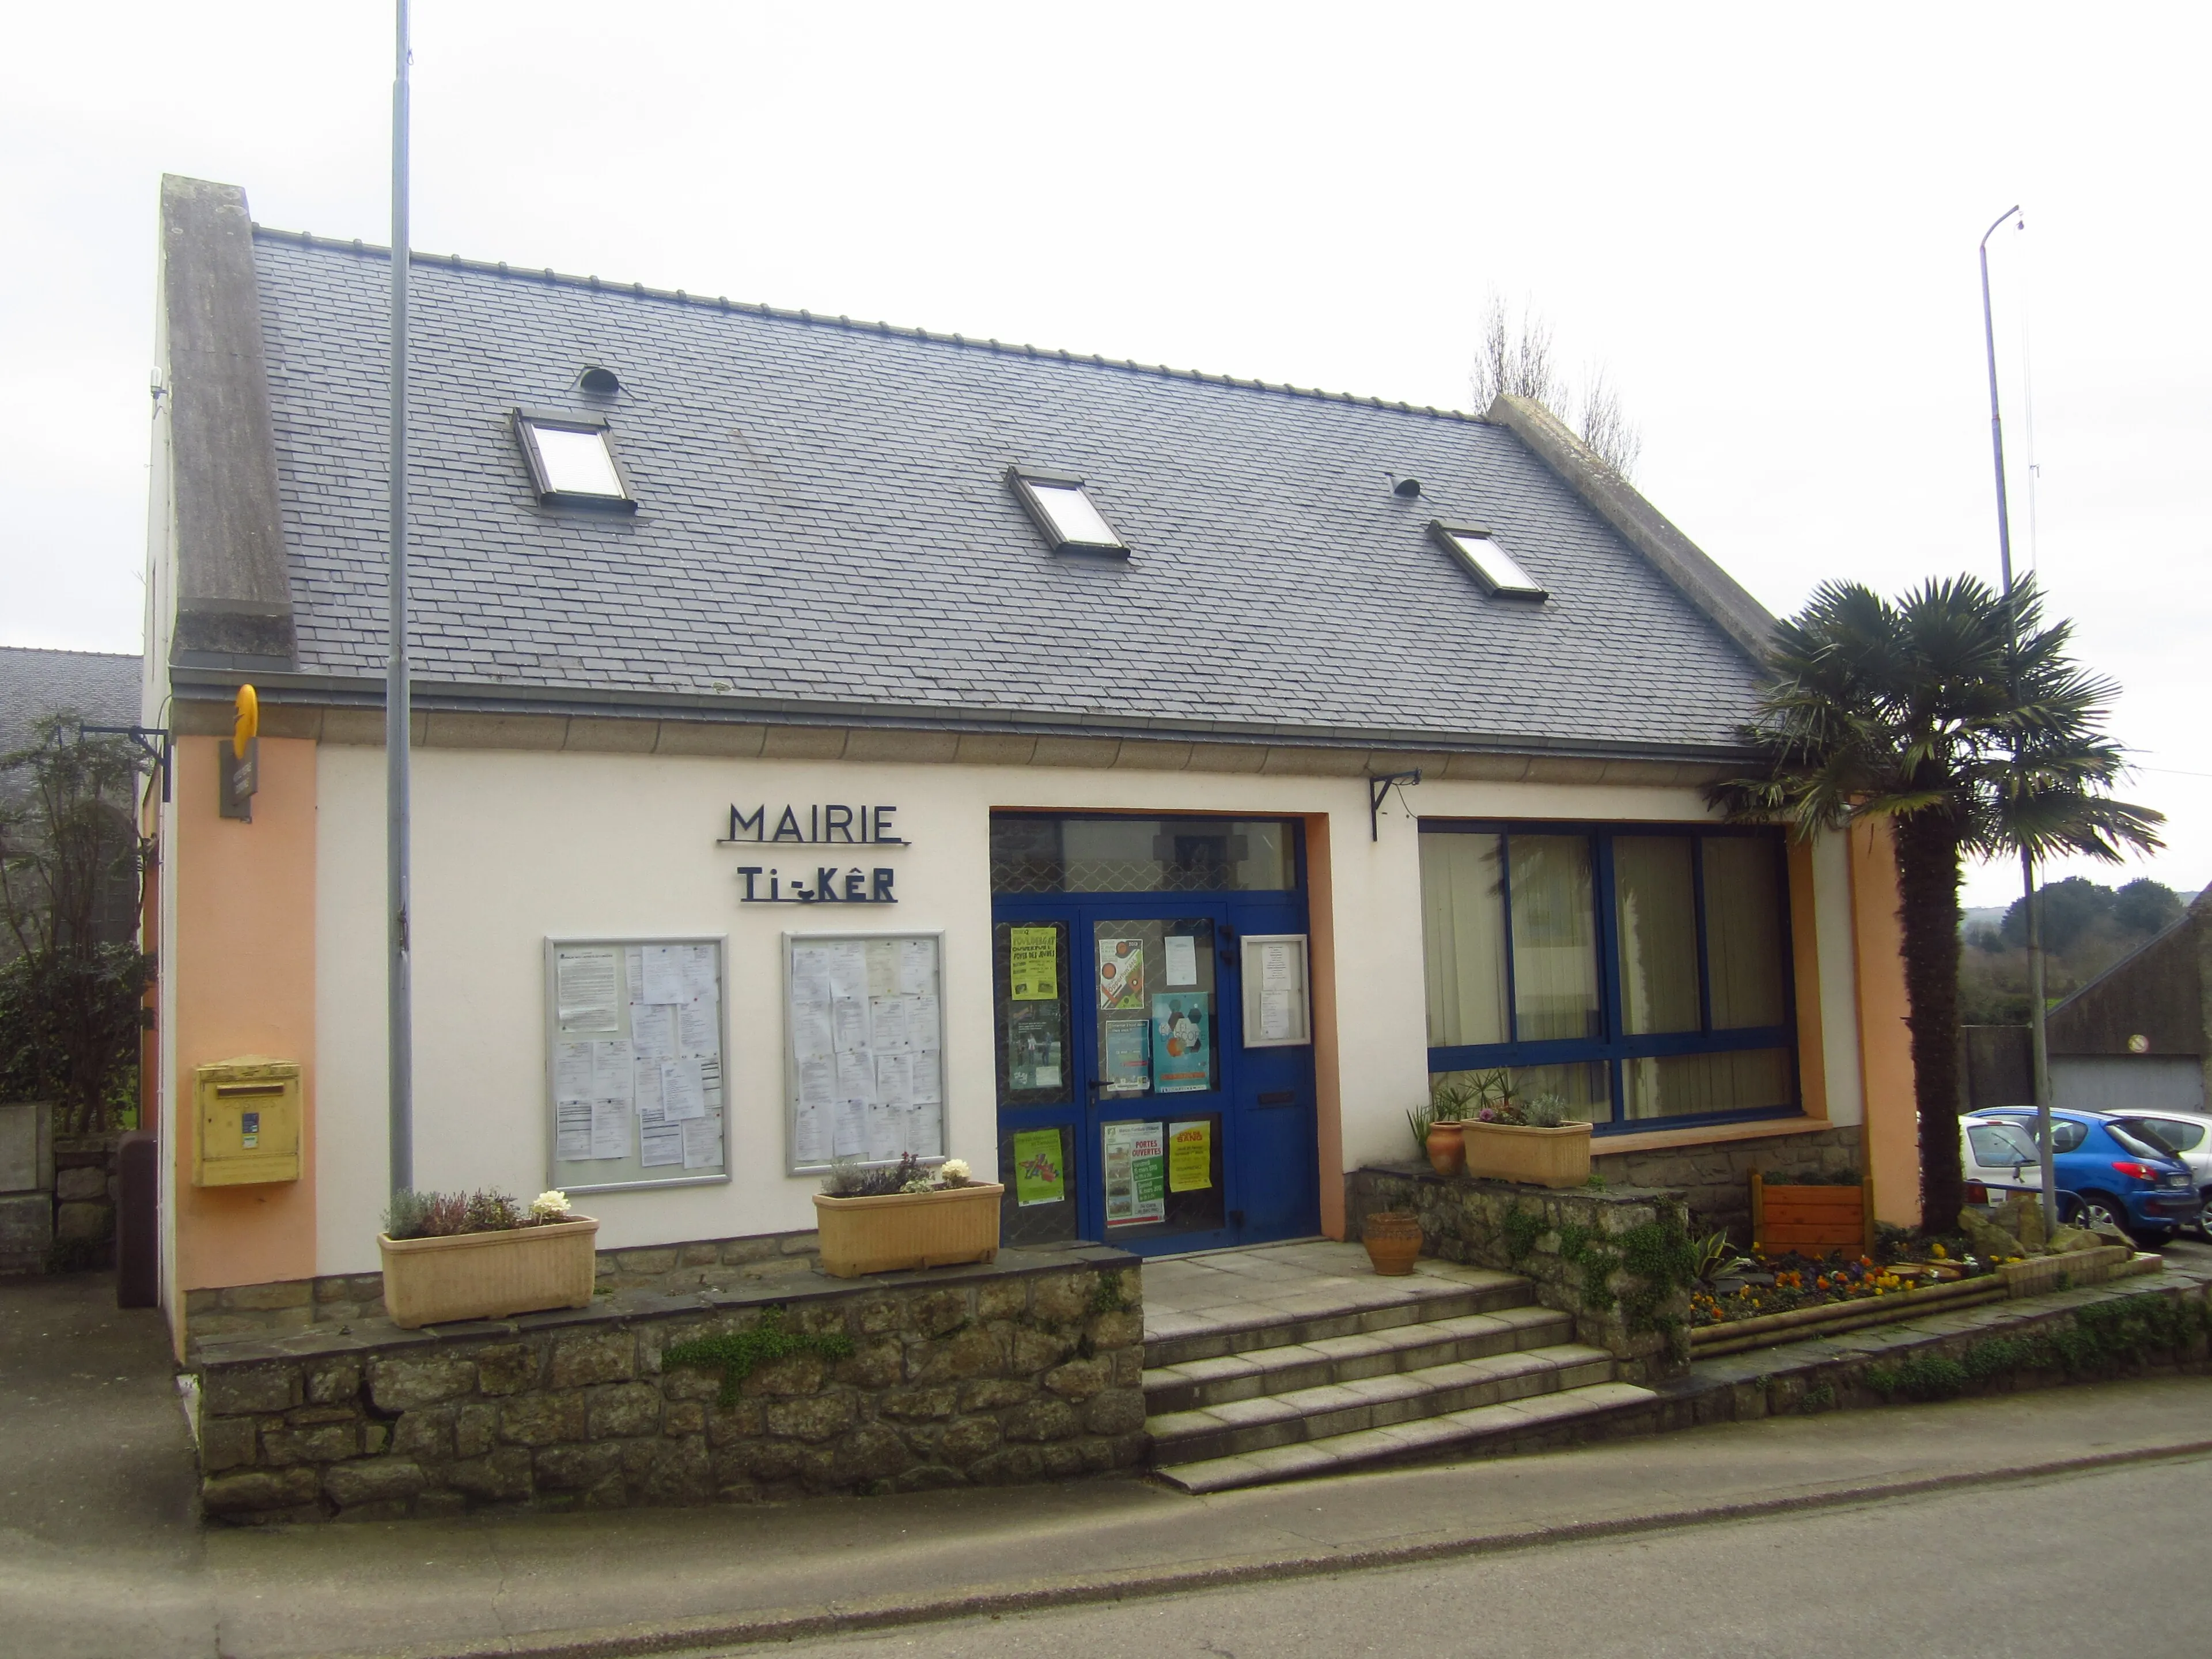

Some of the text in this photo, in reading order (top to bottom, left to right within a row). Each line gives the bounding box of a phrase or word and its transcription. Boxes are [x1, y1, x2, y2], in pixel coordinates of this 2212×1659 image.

[730, 803, 902, 843] MAIRIE
[1028, 951, 1037, 959] DES
[1136, 1140, 1157, 1149] PORTES
[1132, 1147, 1161, 1157] OUVERTES
